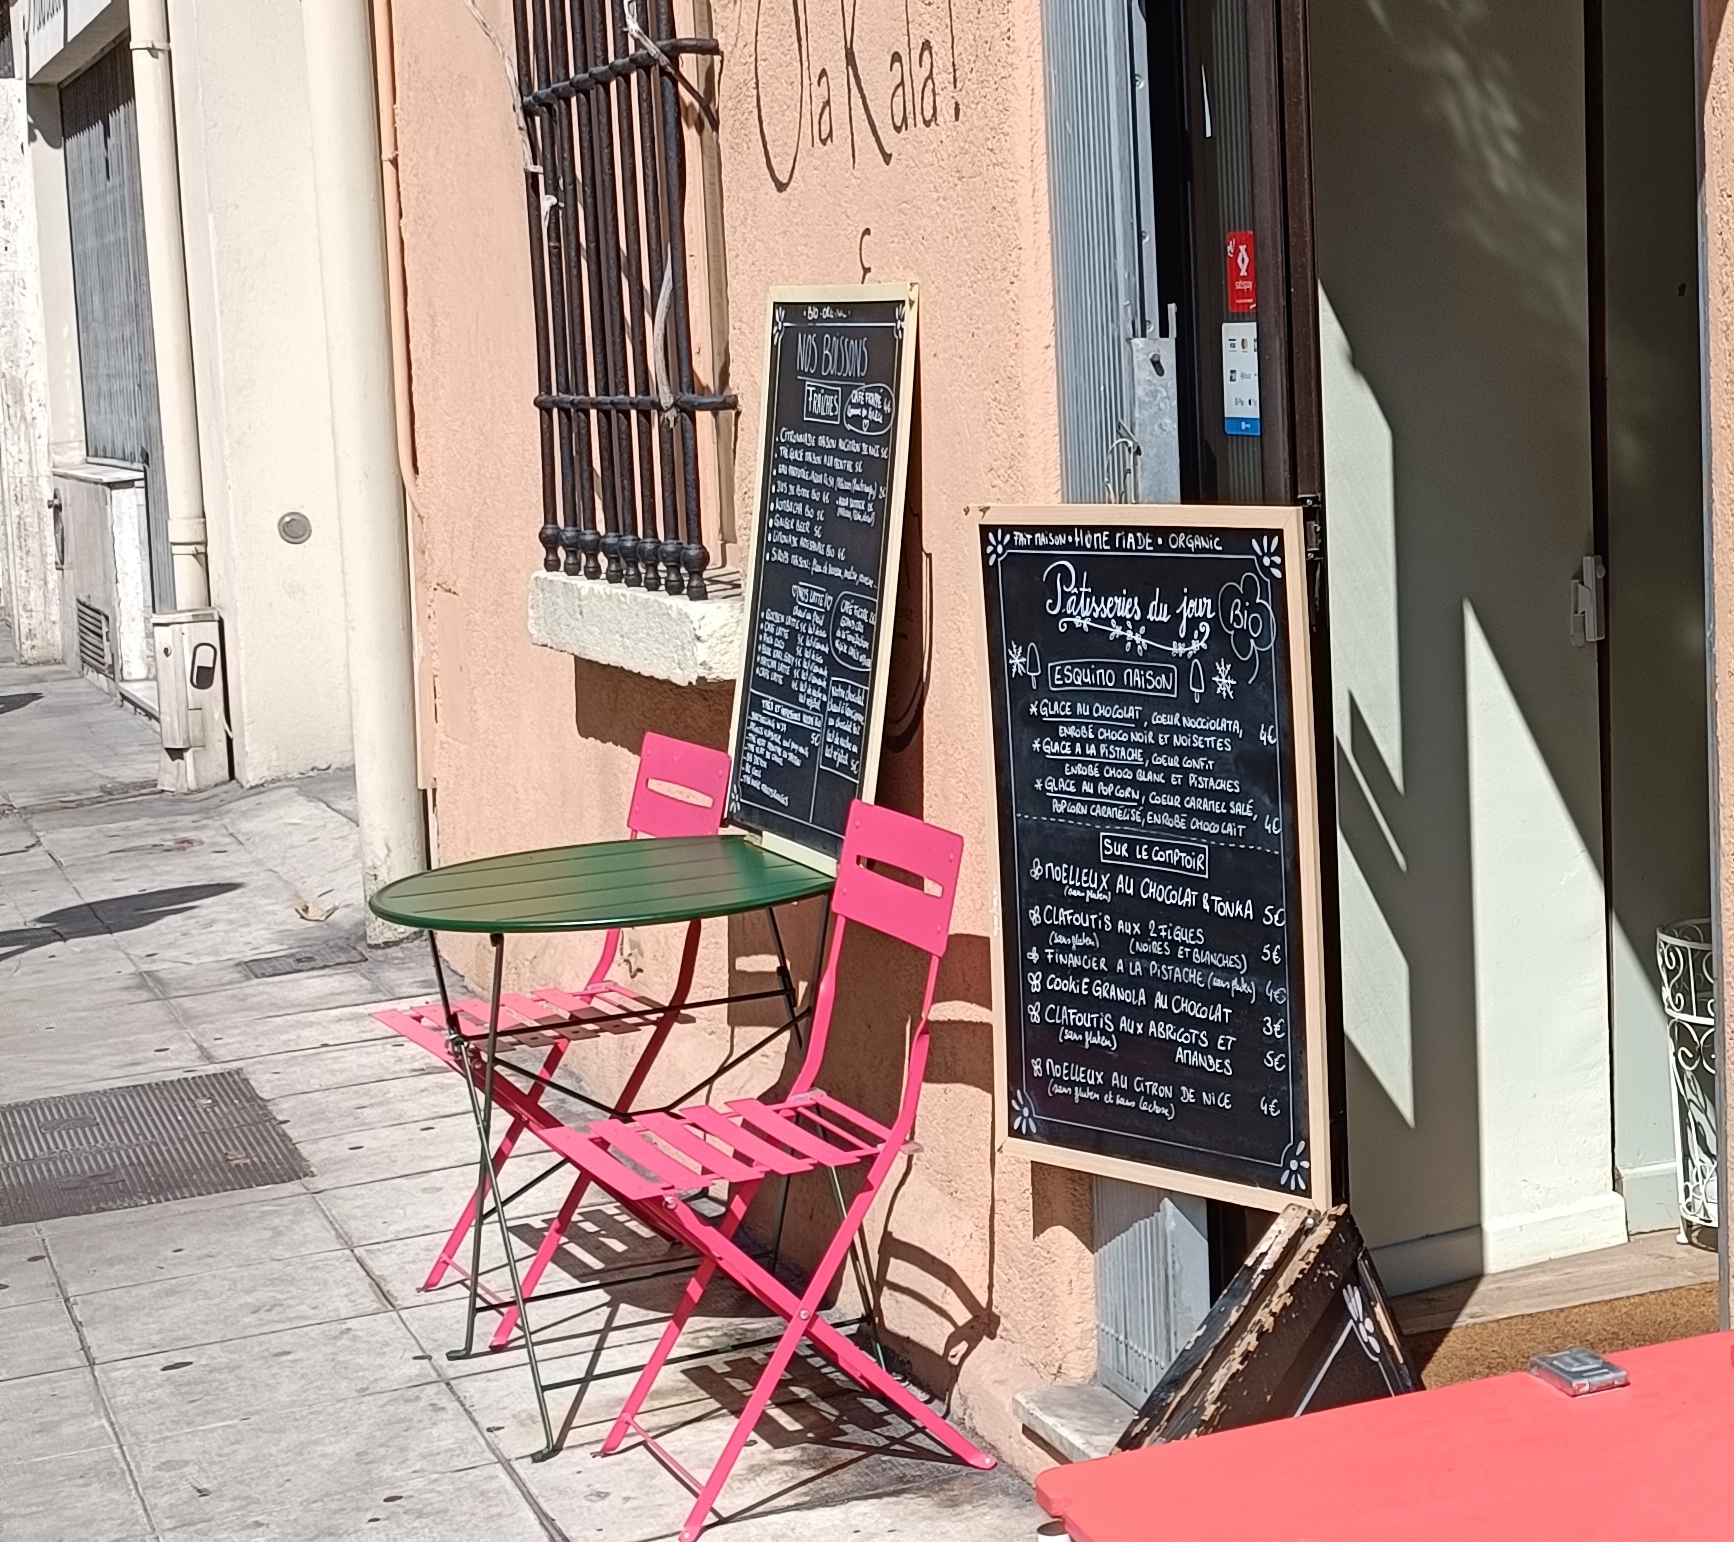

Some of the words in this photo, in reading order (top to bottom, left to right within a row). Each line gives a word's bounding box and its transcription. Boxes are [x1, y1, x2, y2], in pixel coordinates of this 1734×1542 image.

[1013, 532, 1033, 547] FAIT
[1034, 532, 1067, 546] MAISON
[1074, 528, 1110, 550] HOME
[1115, 532, 1154, 551] MADE
[1169, 533, 1224, 552] ORGANIC
[1043, 560, 1141, 621] Pâtisseries
[1147, 588, 1172, 623] du
[1176, 587, 1216, 638] jour
[1054, 665, 1116, 687] ESQUIMO
[1123, 669, 1173, 691] MAISON
[1103, 838, 1129, 858] SUR
[1136, 845, 1149, 859] LE
[1151, 846, 1205, 871] COMPTOIR
[1045, 862, 1110, 891] MOELLEUX
[1116, 875, 1134, 896] AU
[1140, 877, 1199, 907] CHOCOLAT
[1211, 895, 1254, 921] TONKA
[1043, 905, 1112, 932] CLAFOUTIS
[1117, 919, 1142, 936] AUX
[1148, 919, 1158, 938] 2
[1159, 922, 1205, 945] FIGUES
[1044, 948, 1109, 972] FINANCIER
[1117, 959, 1125, 974] A
[1129, 961, 1143, 977] LA
[1150, 961, 1205, 988] PISTACHE
[1046, 973, 1090, 996] COOKIE
[1092, 979, 1147, 1006] GRANOLA
[1154, 992, 1168, 1011] AU
[1171, 995, 1233, 1024] CHOCOLAT
[1044, 1004, 1115, 1032] CLAFOUTIS
[1119, 1015, 1144, 1035] AUX
[1148, 1022, 1209, 1048] ABRICOTS
[1217, 1035, 1237, 1052] ET
[1045, 1058, 1104, 1086] MOELLEUX
[1111, 1071, 1128, 1090] AU
[1133, 1077, 1174, 1099] CITRON
[1180, 1085, 1196, 1103] DE
[1202, 1091, 1233, 1110] NICE
